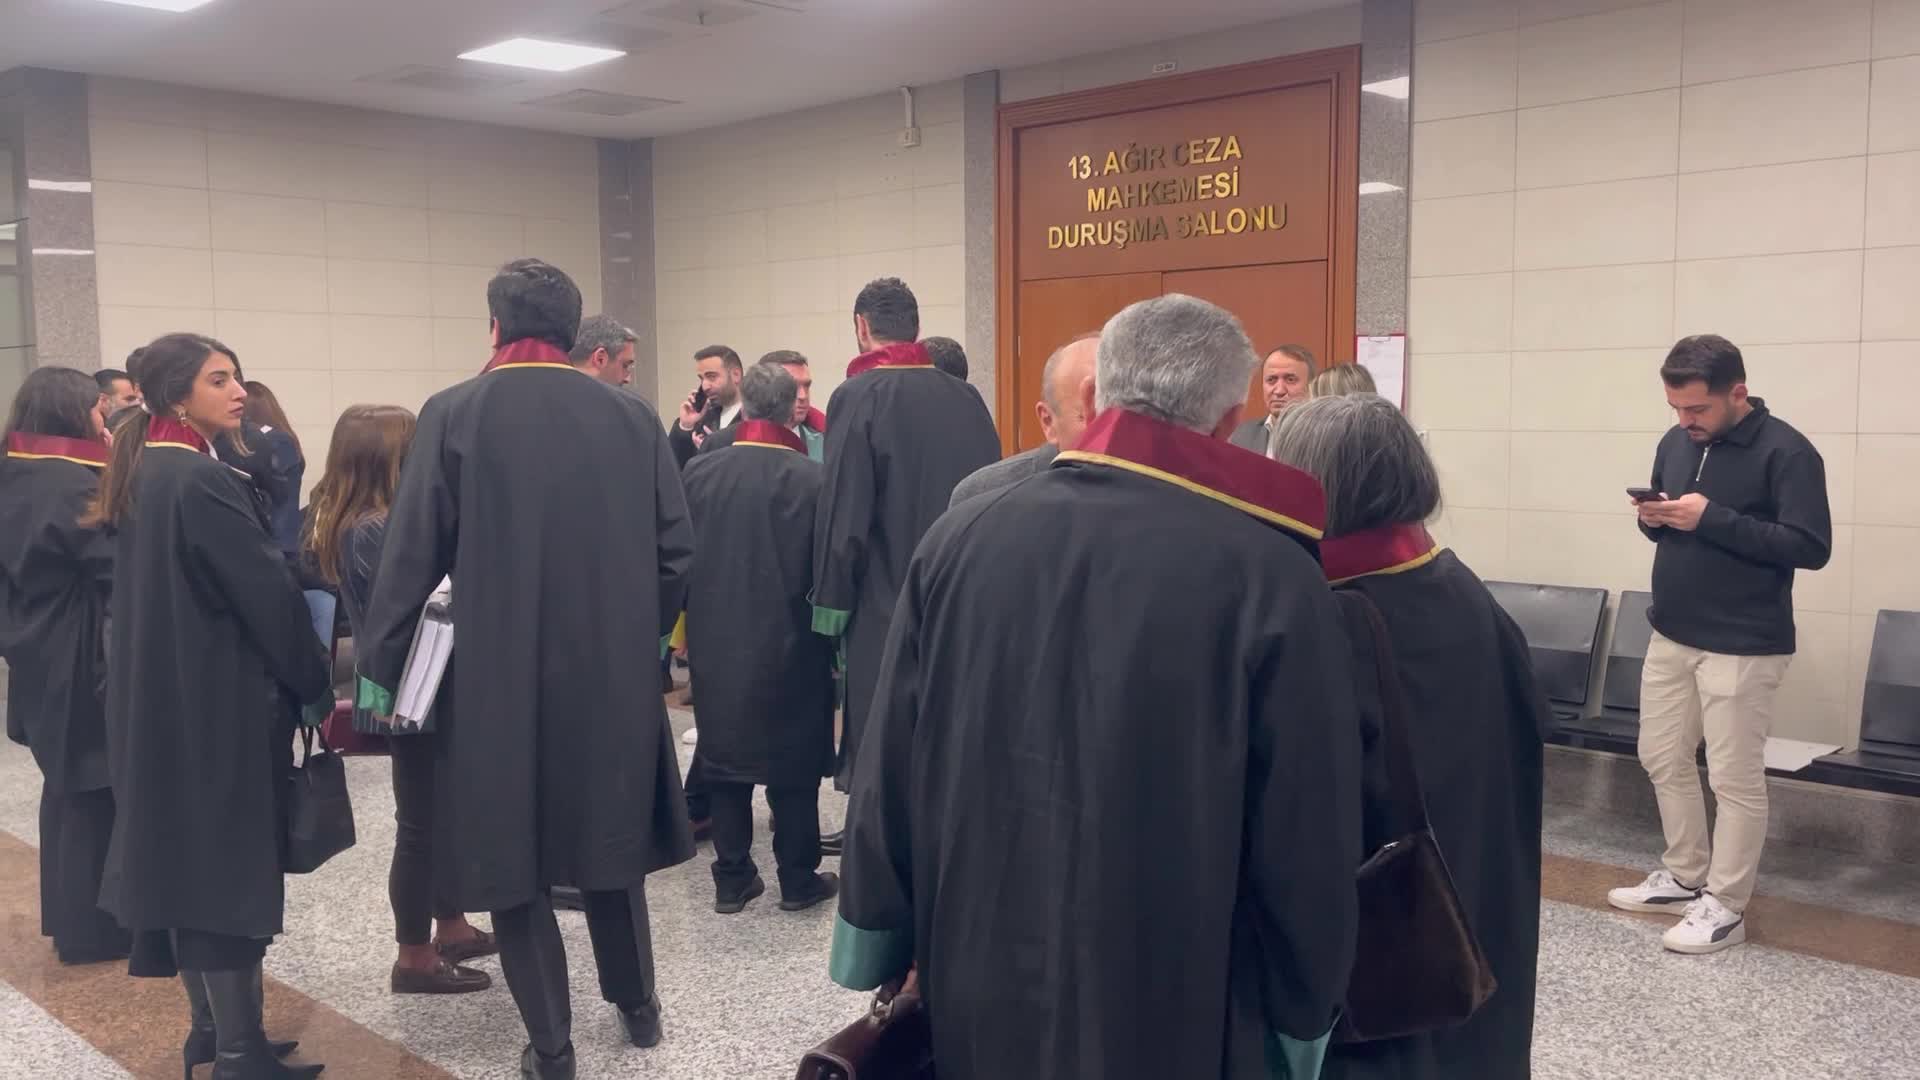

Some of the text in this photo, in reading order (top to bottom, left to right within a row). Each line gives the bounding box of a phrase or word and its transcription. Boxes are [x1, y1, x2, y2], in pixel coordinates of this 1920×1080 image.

[1067, 135, 1243, 180] 13. AĞIR CEZA
[1086, 167, 1240, 213] MAHKEMESİ
[1047, 203, 1288, 250] DURUŞMA SALONU
